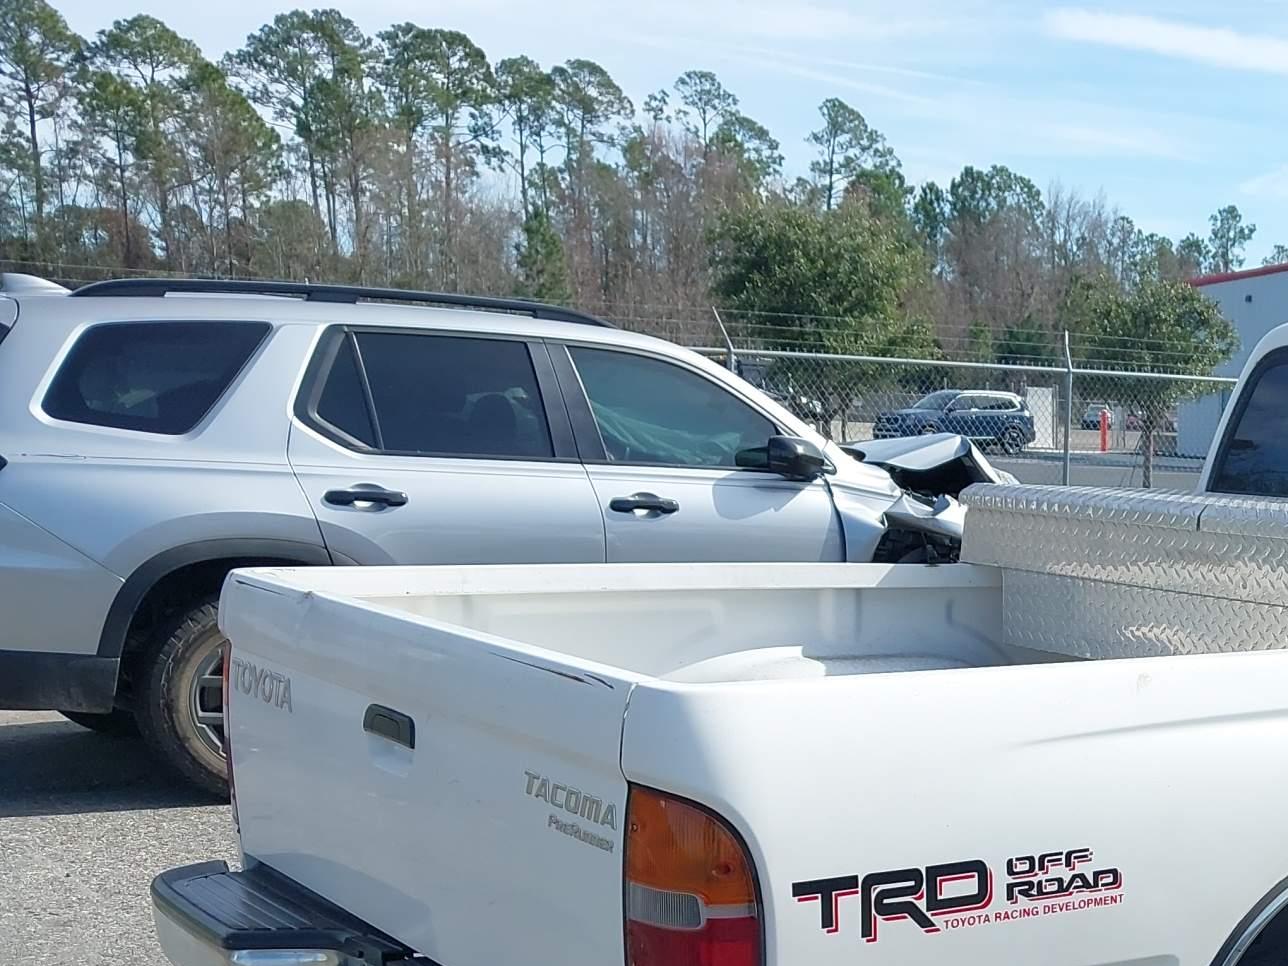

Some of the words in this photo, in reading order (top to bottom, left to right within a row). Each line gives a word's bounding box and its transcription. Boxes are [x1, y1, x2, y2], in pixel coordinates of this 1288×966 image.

[232, 657, 294, 714] TOYOTA
[524, 769, 618, 831] TACOMA
[1005, 847, 1095, 879] OFF
[1005, 867, 1124, 905] ROAD
[791, 859, 993, 944] TRD
[943, 913, 991, 931] TOYOTA
[993, 905, 1040, 922] RACING
[1042, 893, 1125, 915] DEVELOPMENT
